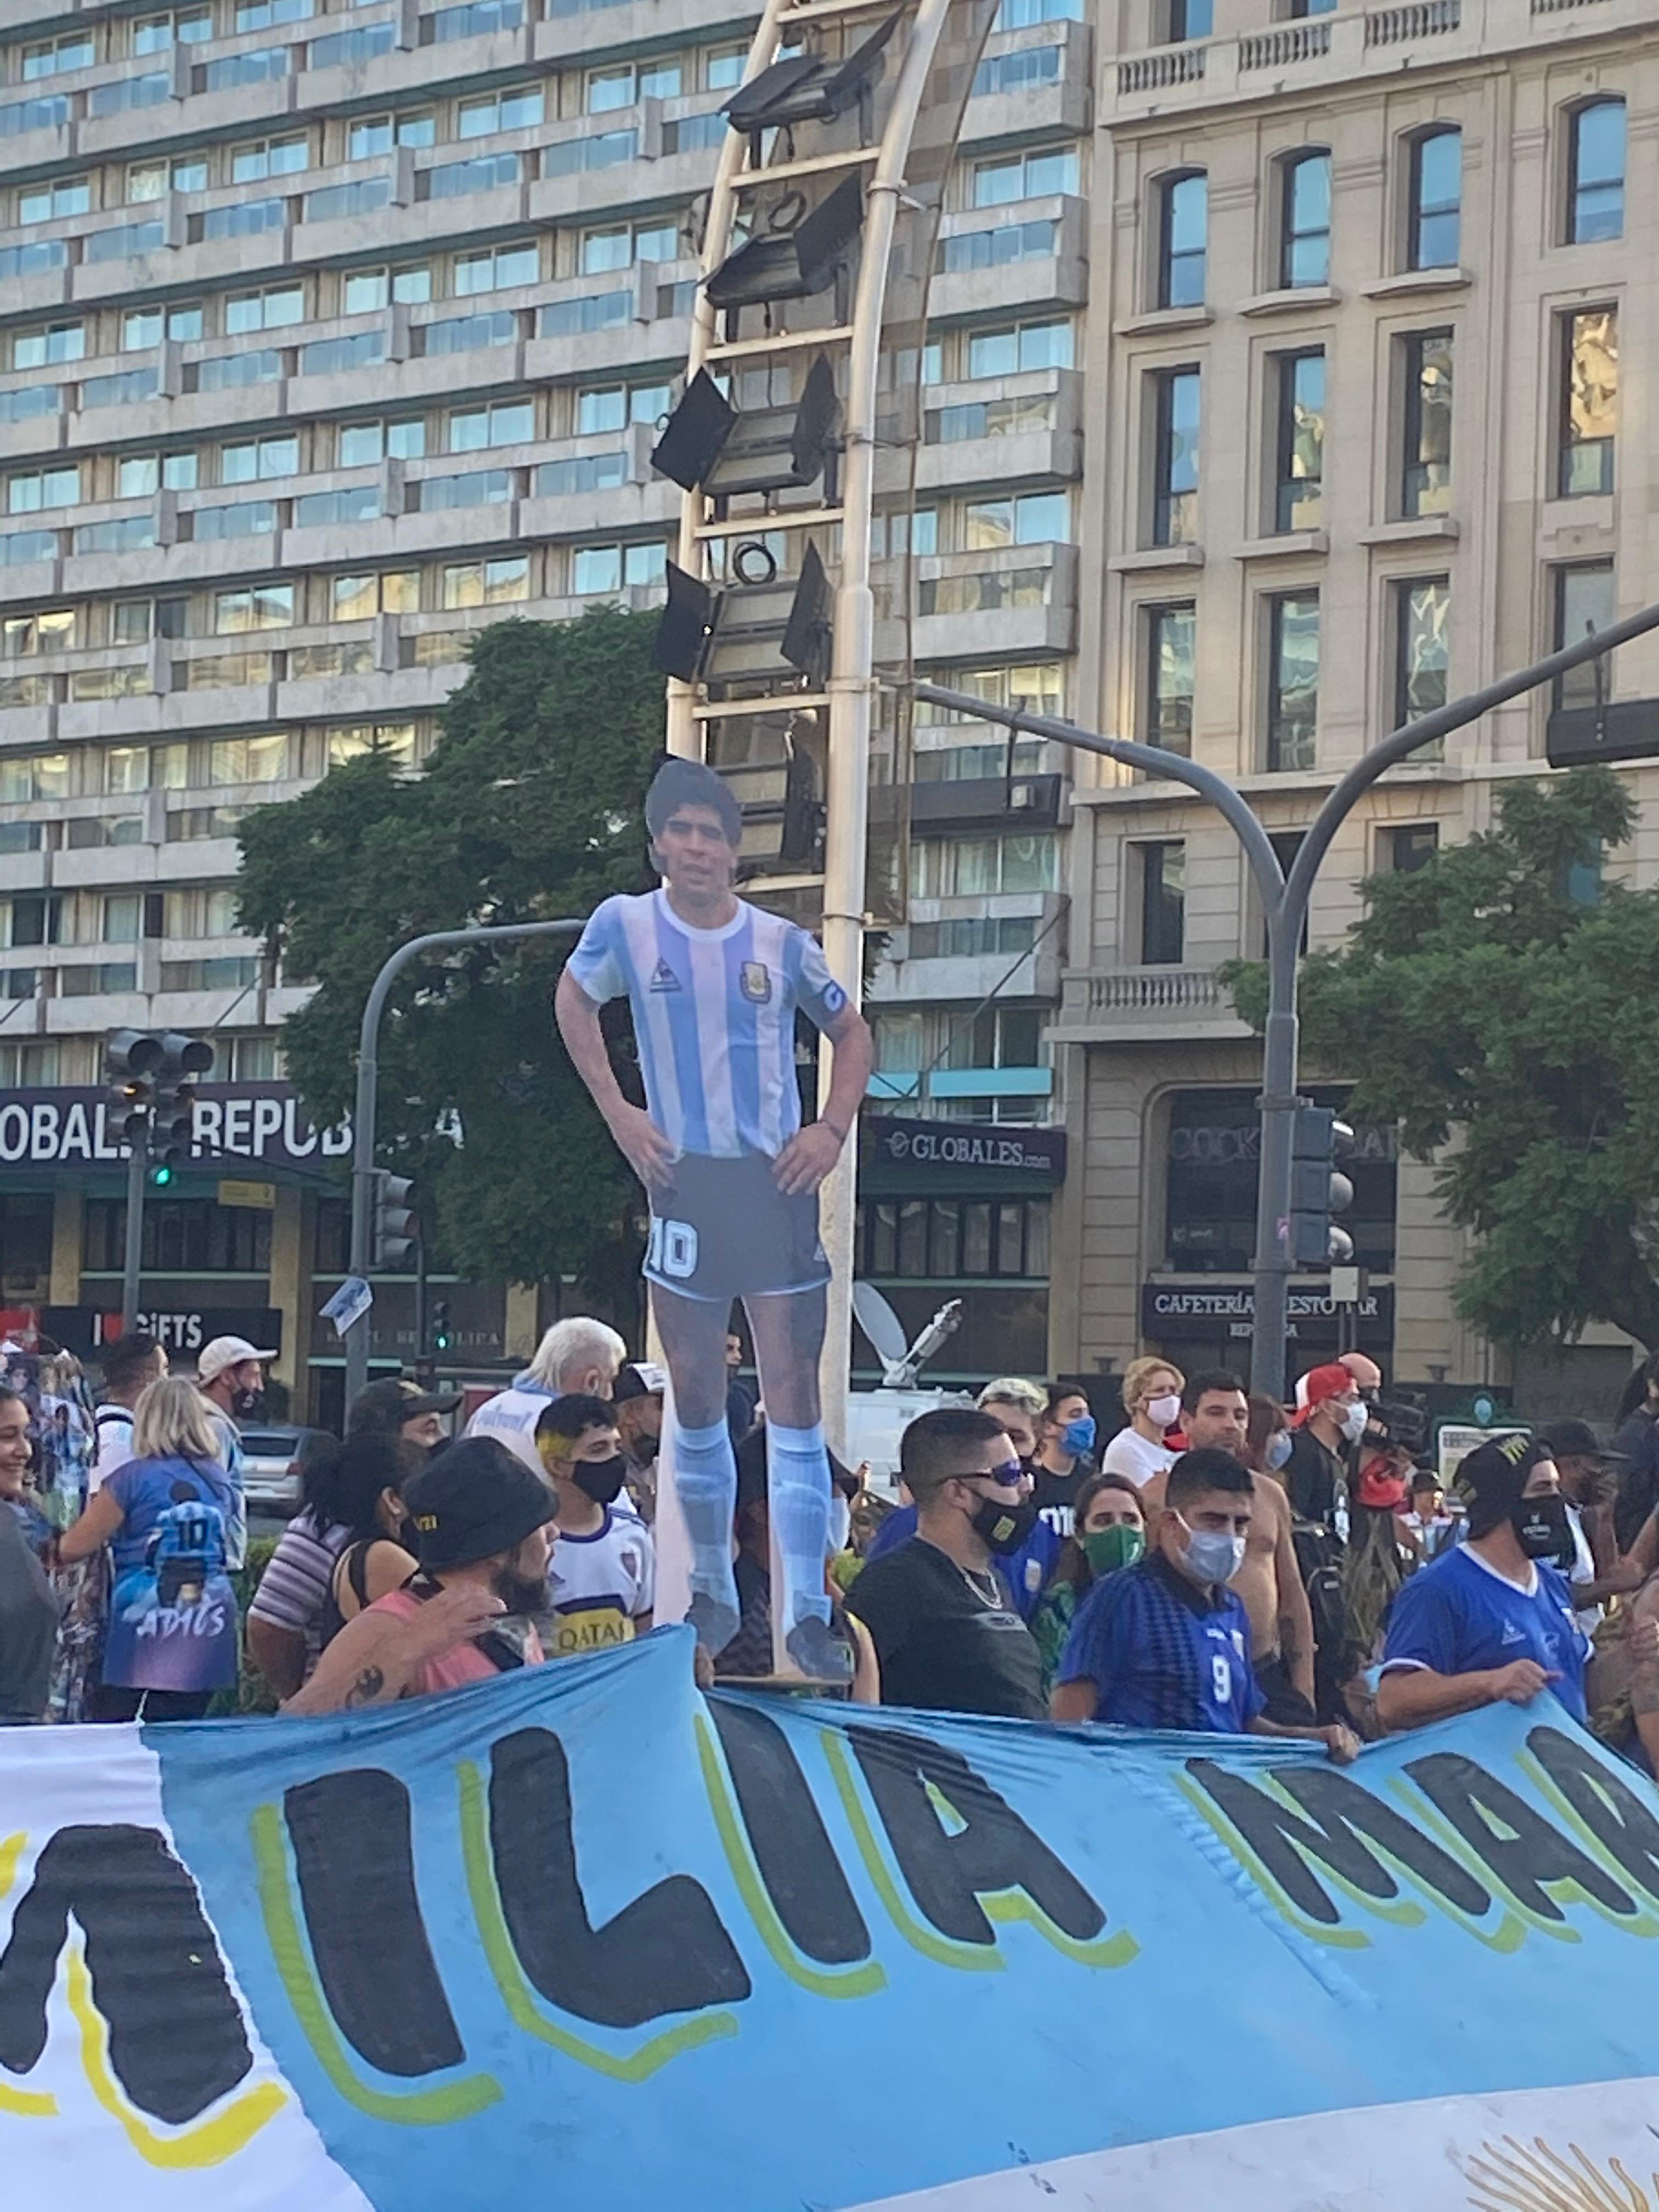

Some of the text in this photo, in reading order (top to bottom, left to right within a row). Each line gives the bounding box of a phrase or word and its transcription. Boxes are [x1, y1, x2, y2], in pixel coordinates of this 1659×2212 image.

[650, 1216, 698, 1278] 10
[1286, 1295, 1335, 1316] ESTO
[1212, 1655, 1231, 1703] 9
